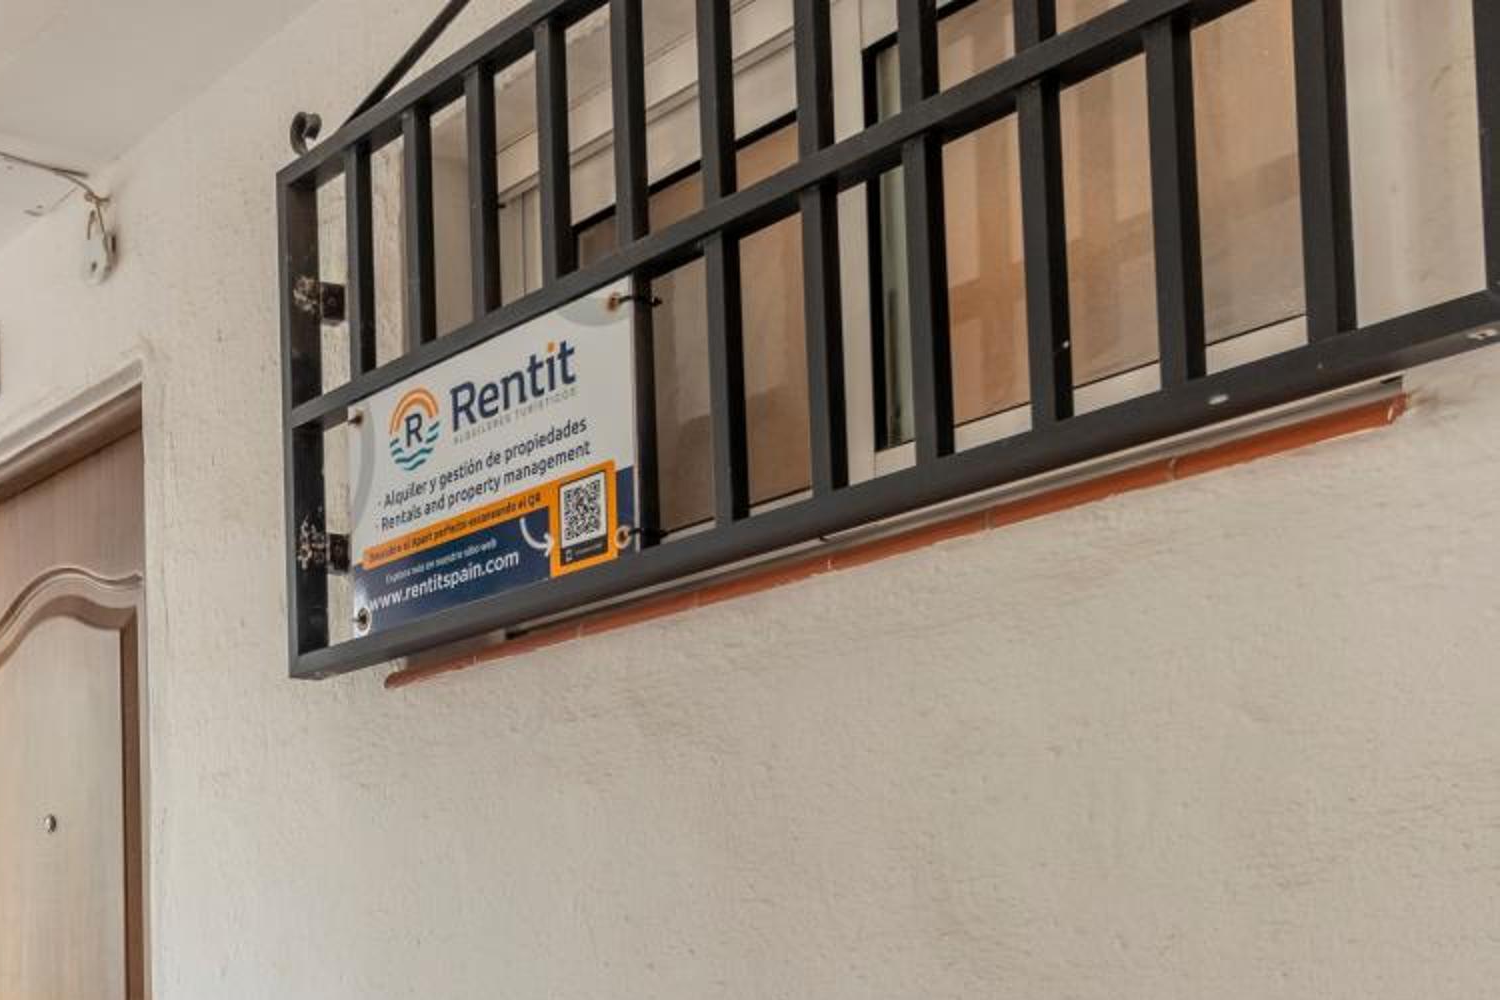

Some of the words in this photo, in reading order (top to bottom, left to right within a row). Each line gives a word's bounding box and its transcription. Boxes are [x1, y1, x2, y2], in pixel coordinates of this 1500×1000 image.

[403, 412, 422, 448] R
[449, 340, 576, 433] Rentit
[381, 505, 421, 531] Rentals
[424, 495, 444, 514] and
[447, 477, 499, 509] property
[503, 440, 590, 487] management
[383, 480, 427, 508] Alquiler
[429, 477, 436, 494] y
[439, 458, 482, 487] gestión
[485, 450, 500, 466] de
[504, 416, 587, 463] propiedades
[369, 550, 519, 611] www.rentitspain.com
